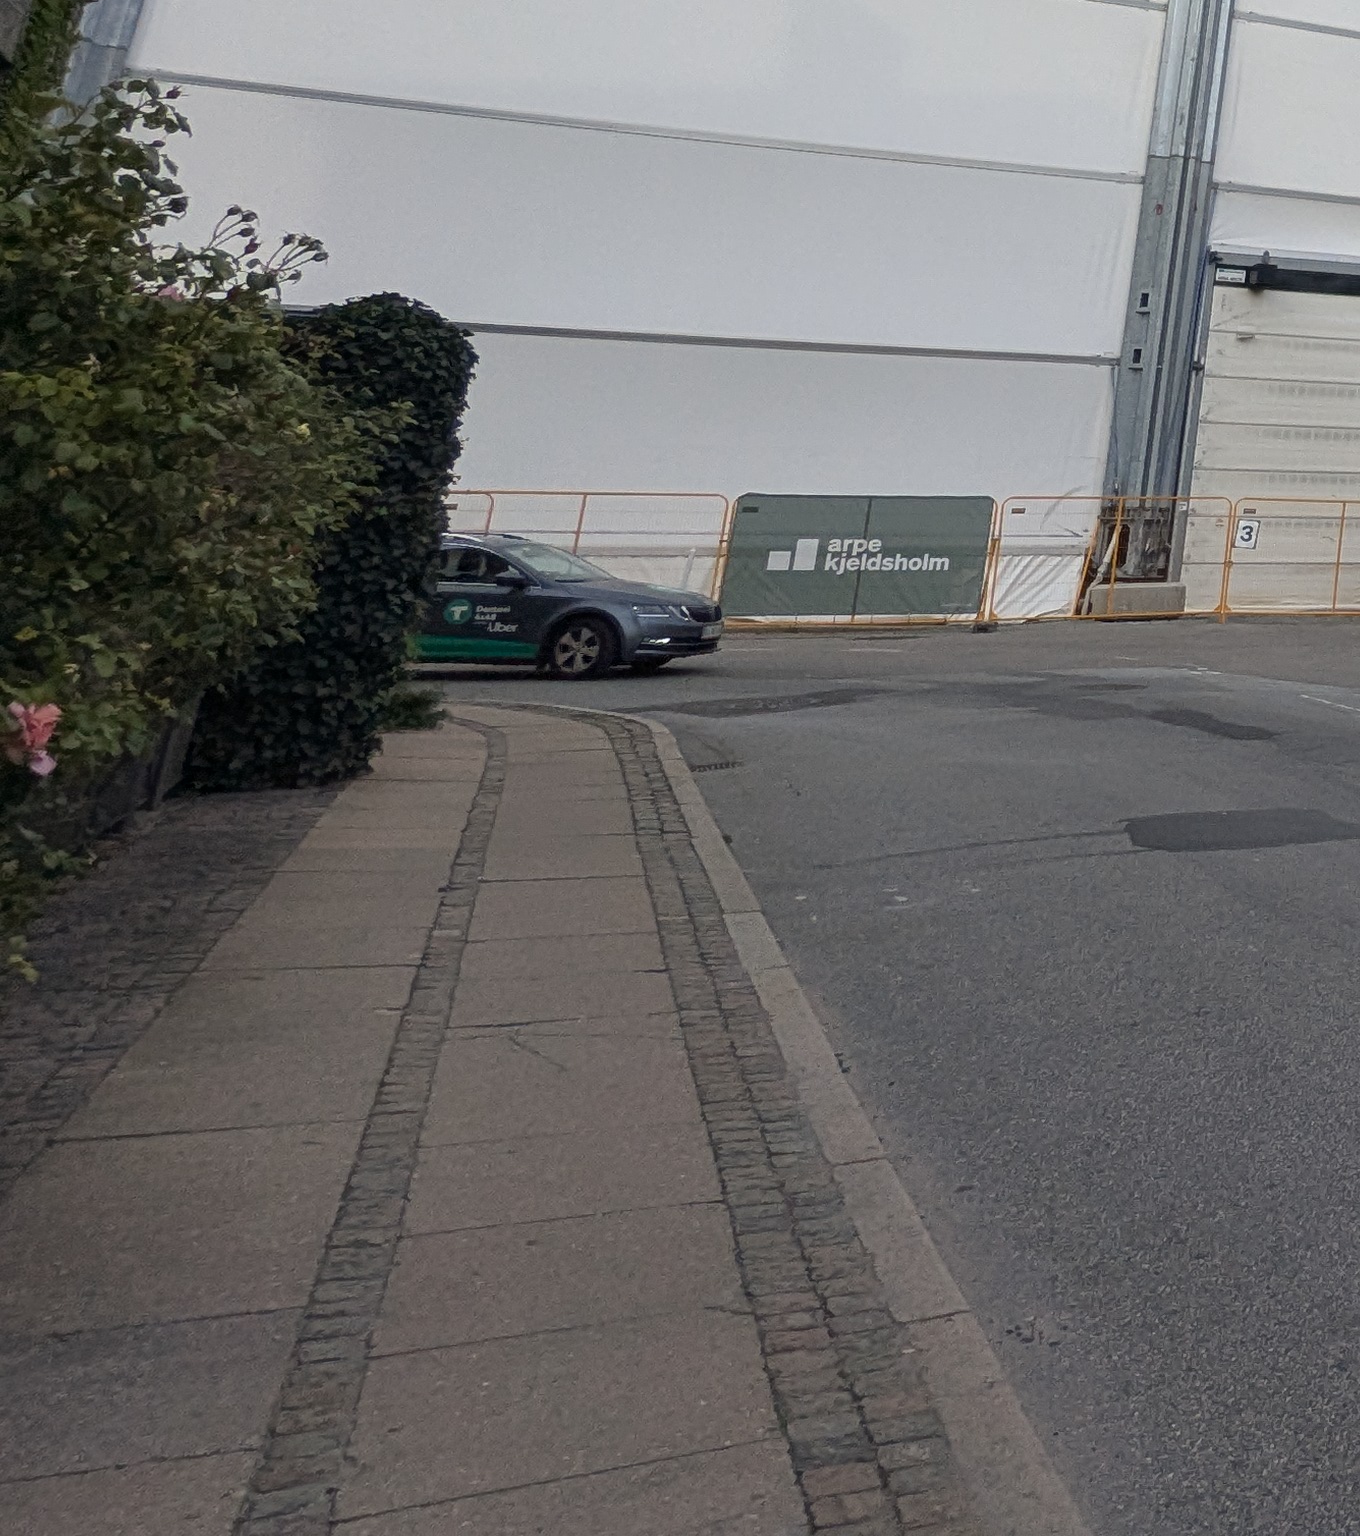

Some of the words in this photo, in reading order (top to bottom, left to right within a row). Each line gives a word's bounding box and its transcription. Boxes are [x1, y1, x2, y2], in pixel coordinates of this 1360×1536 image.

[1240, 525, 1254, 542] 3
[827, 538, 882, 556] arpe
[824, 553, 950, 576] kjeldsholm
